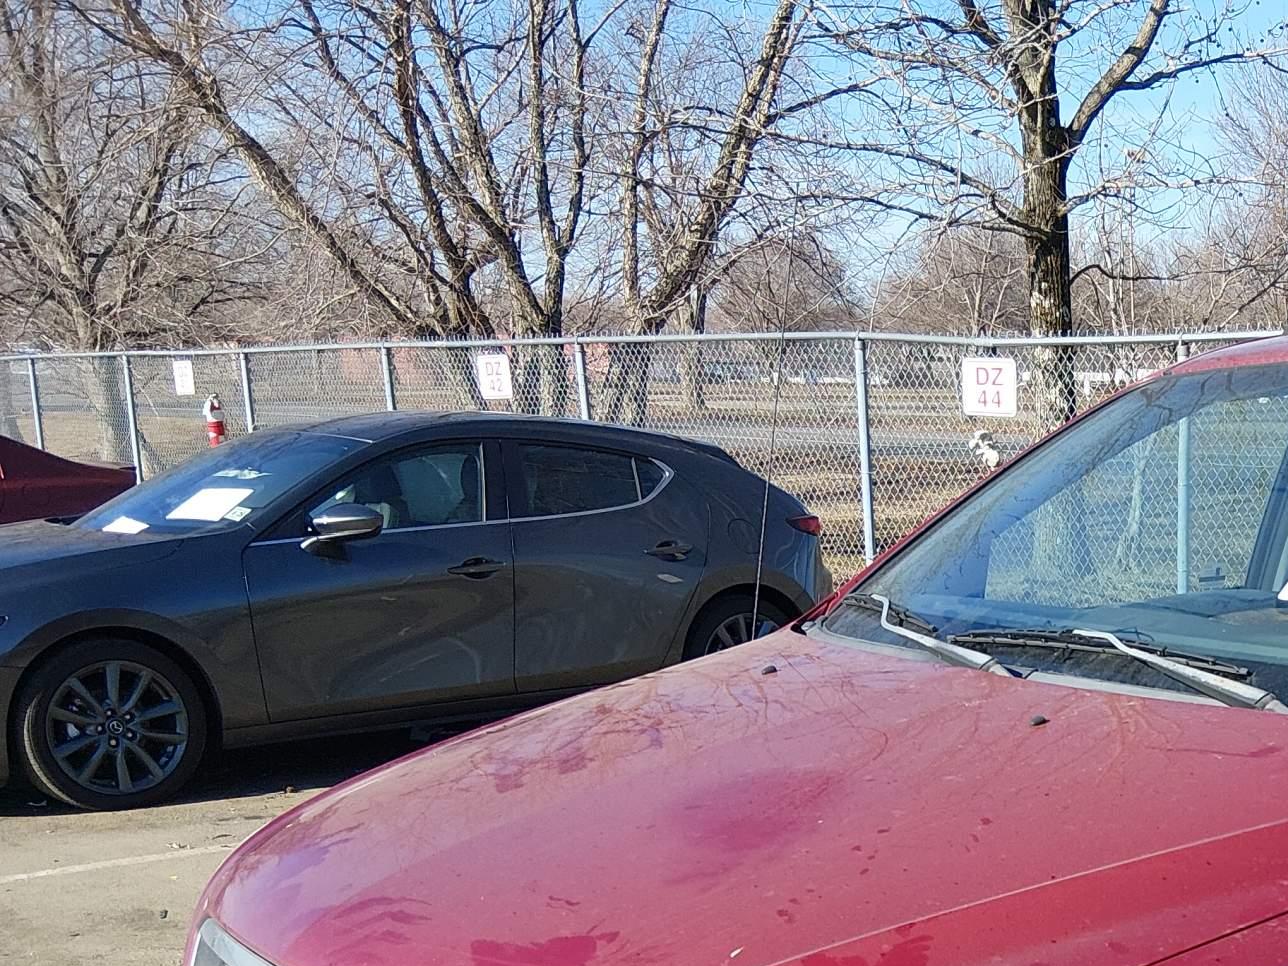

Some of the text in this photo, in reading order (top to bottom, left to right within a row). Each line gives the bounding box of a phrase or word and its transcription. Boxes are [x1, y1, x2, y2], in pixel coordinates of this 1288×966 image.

[485, 362, 503, 376] DZ
[976, 367, 1004, 386] DZ
[977, 390, 1002, 408] 44
